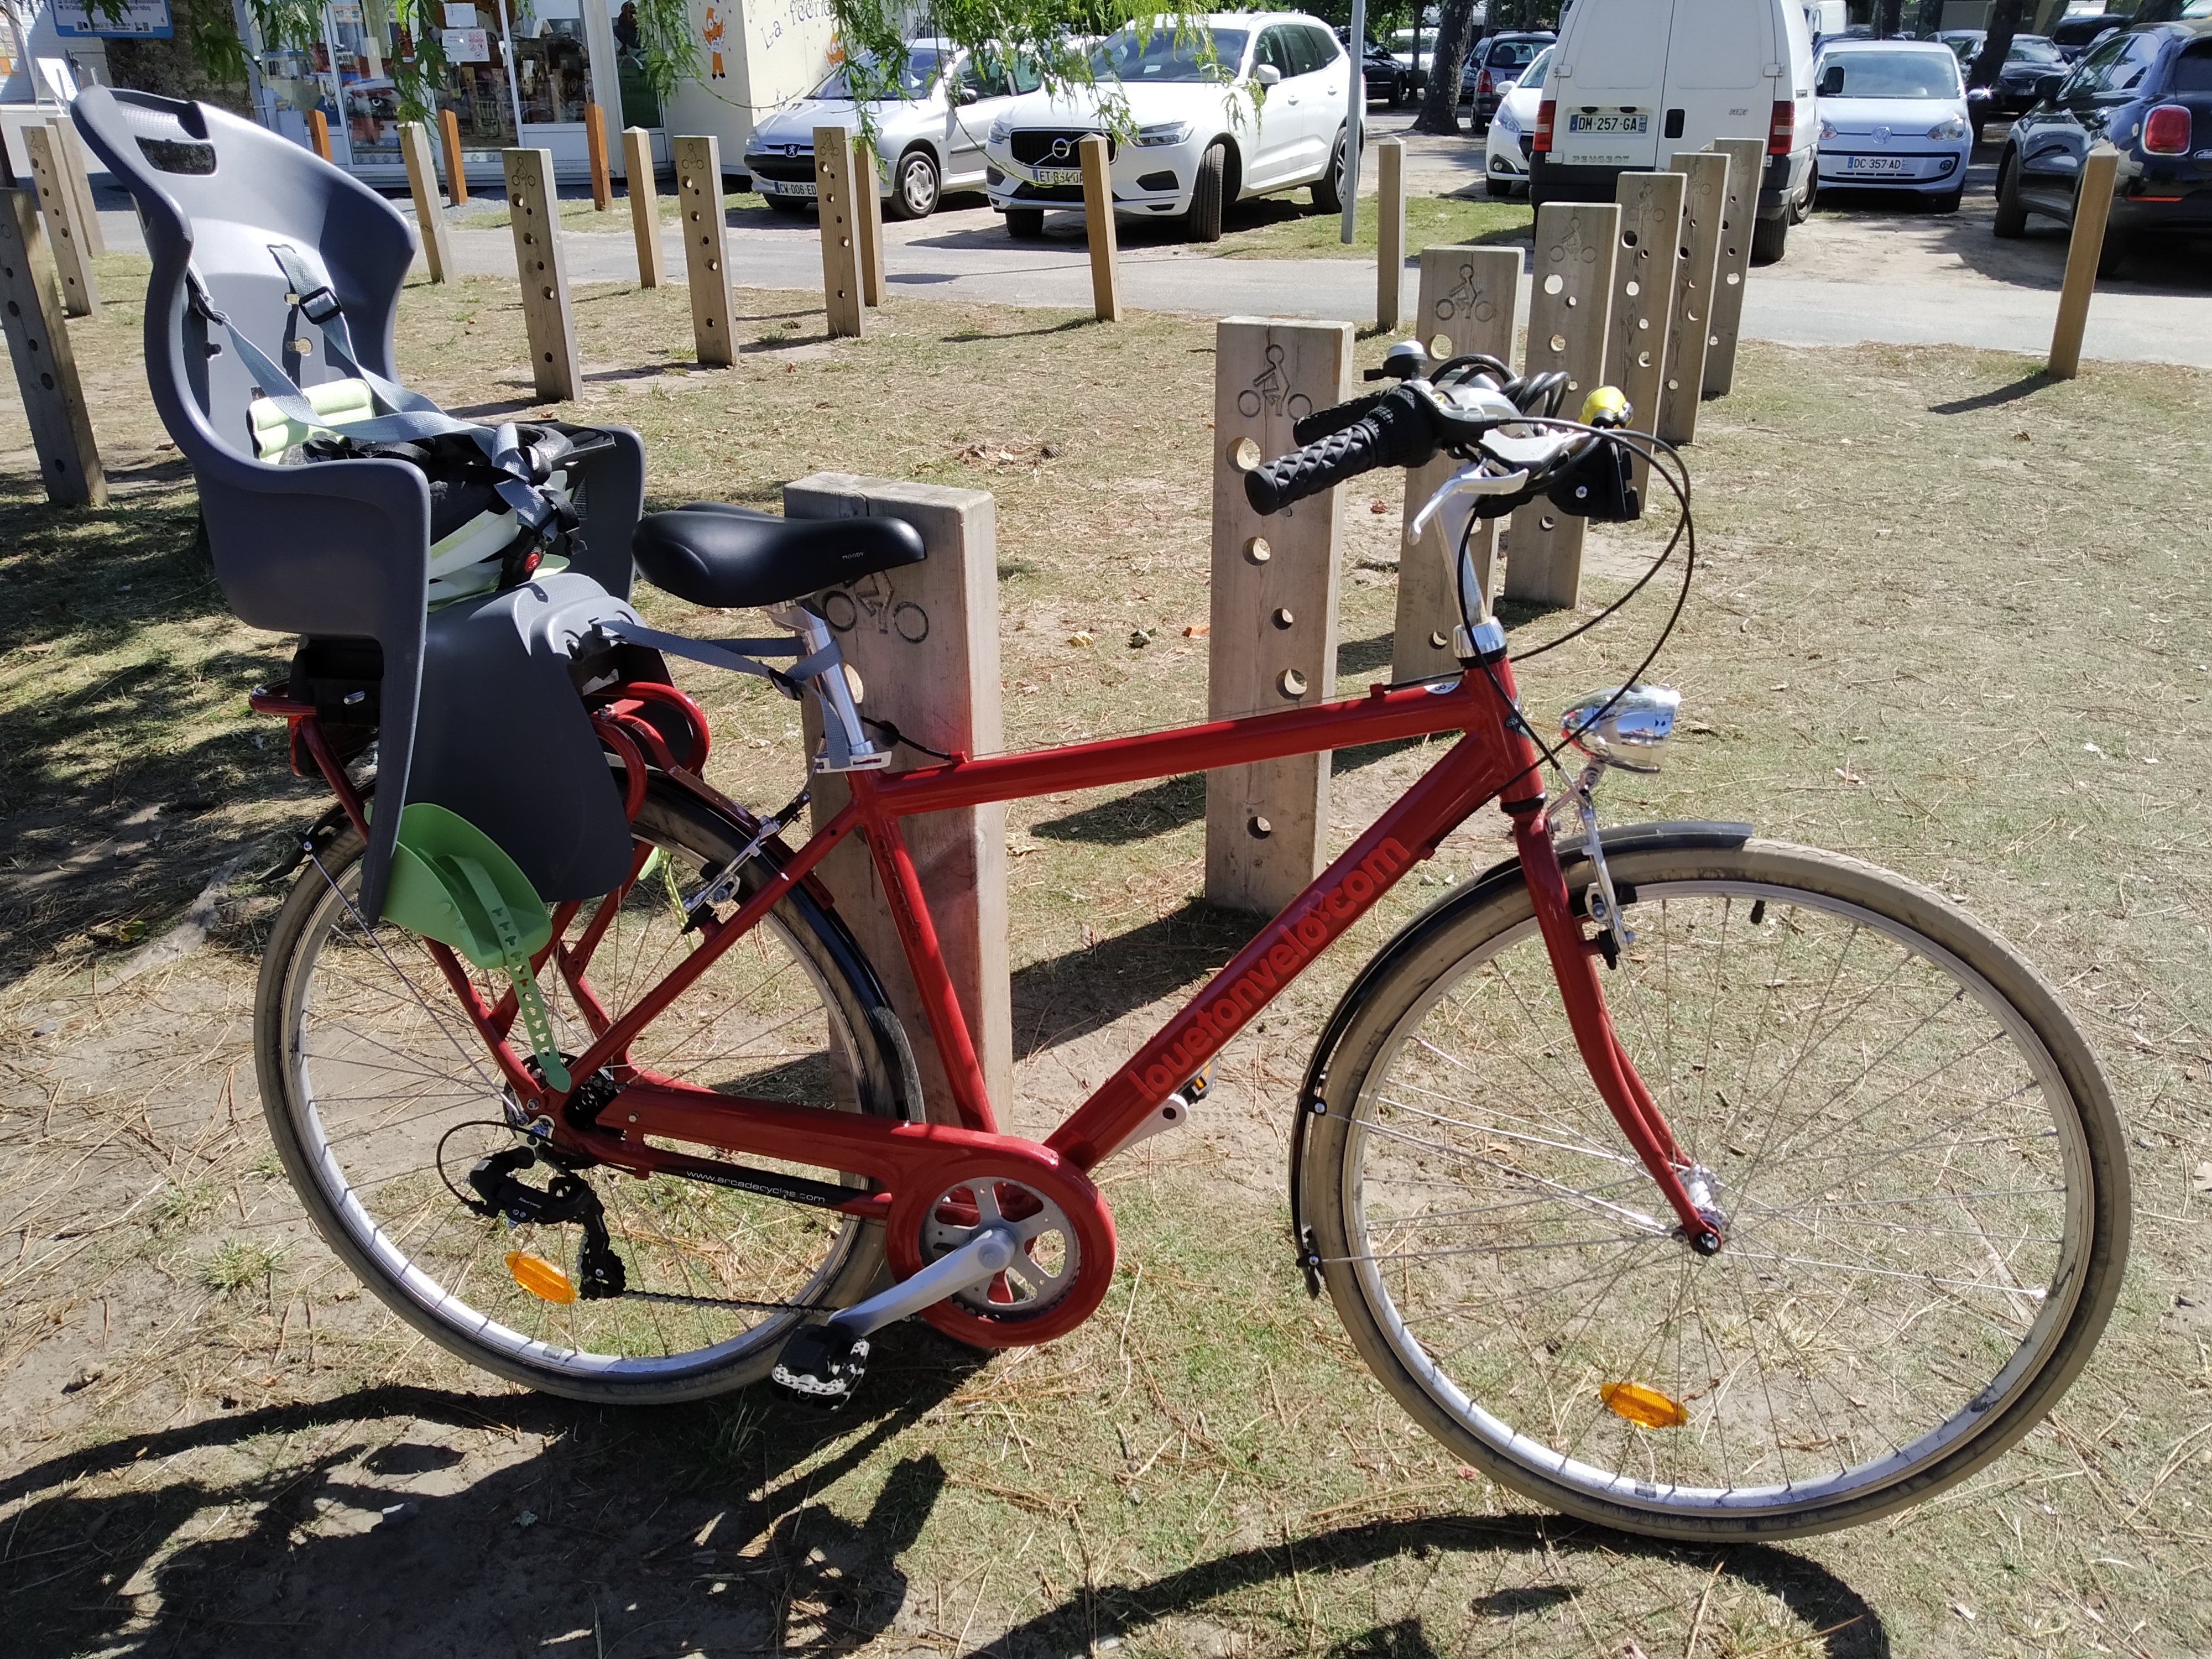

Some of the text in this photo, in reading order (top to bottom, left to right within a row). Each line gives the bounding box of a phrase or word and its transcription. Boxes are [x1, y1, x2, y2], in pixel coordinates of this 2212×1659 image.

[760, 20, 782, 50] La
[1578, 117, 1637, 131] DM-257-GA
[1854, 158, 1901, 169] DC-357-AD
[779, 184, 817, 195] CW-006-ED
[842, 551, 864, 560] MOODY
[1127, 837, 1411, 1101] louetonvelo.com
